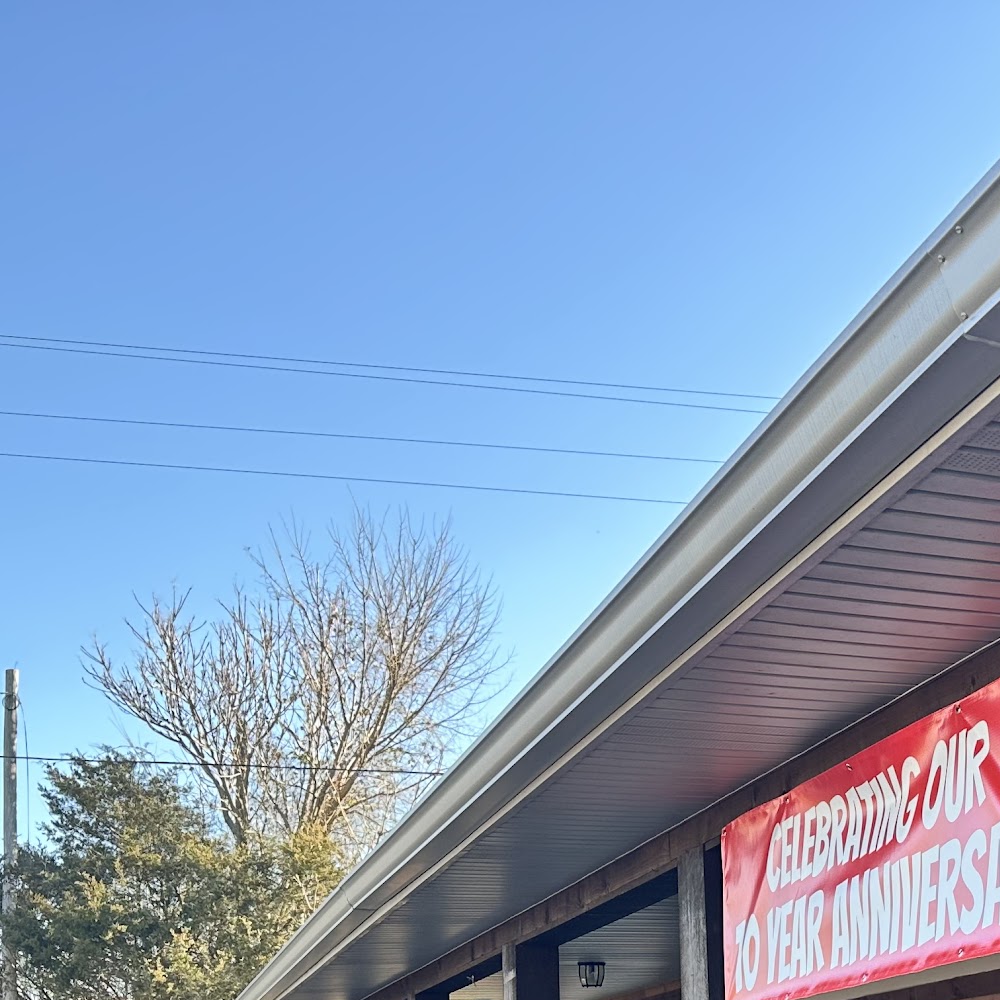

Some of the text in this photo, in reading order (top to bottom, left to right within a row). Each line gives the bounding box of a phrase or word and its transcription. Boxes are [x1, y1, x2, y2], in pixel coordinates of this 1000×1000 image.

[767, 721, 990, 892] CELEBRATING OUR
[735, 914, 760, 993] 10
[767, 889, 826, 985] YEAR
